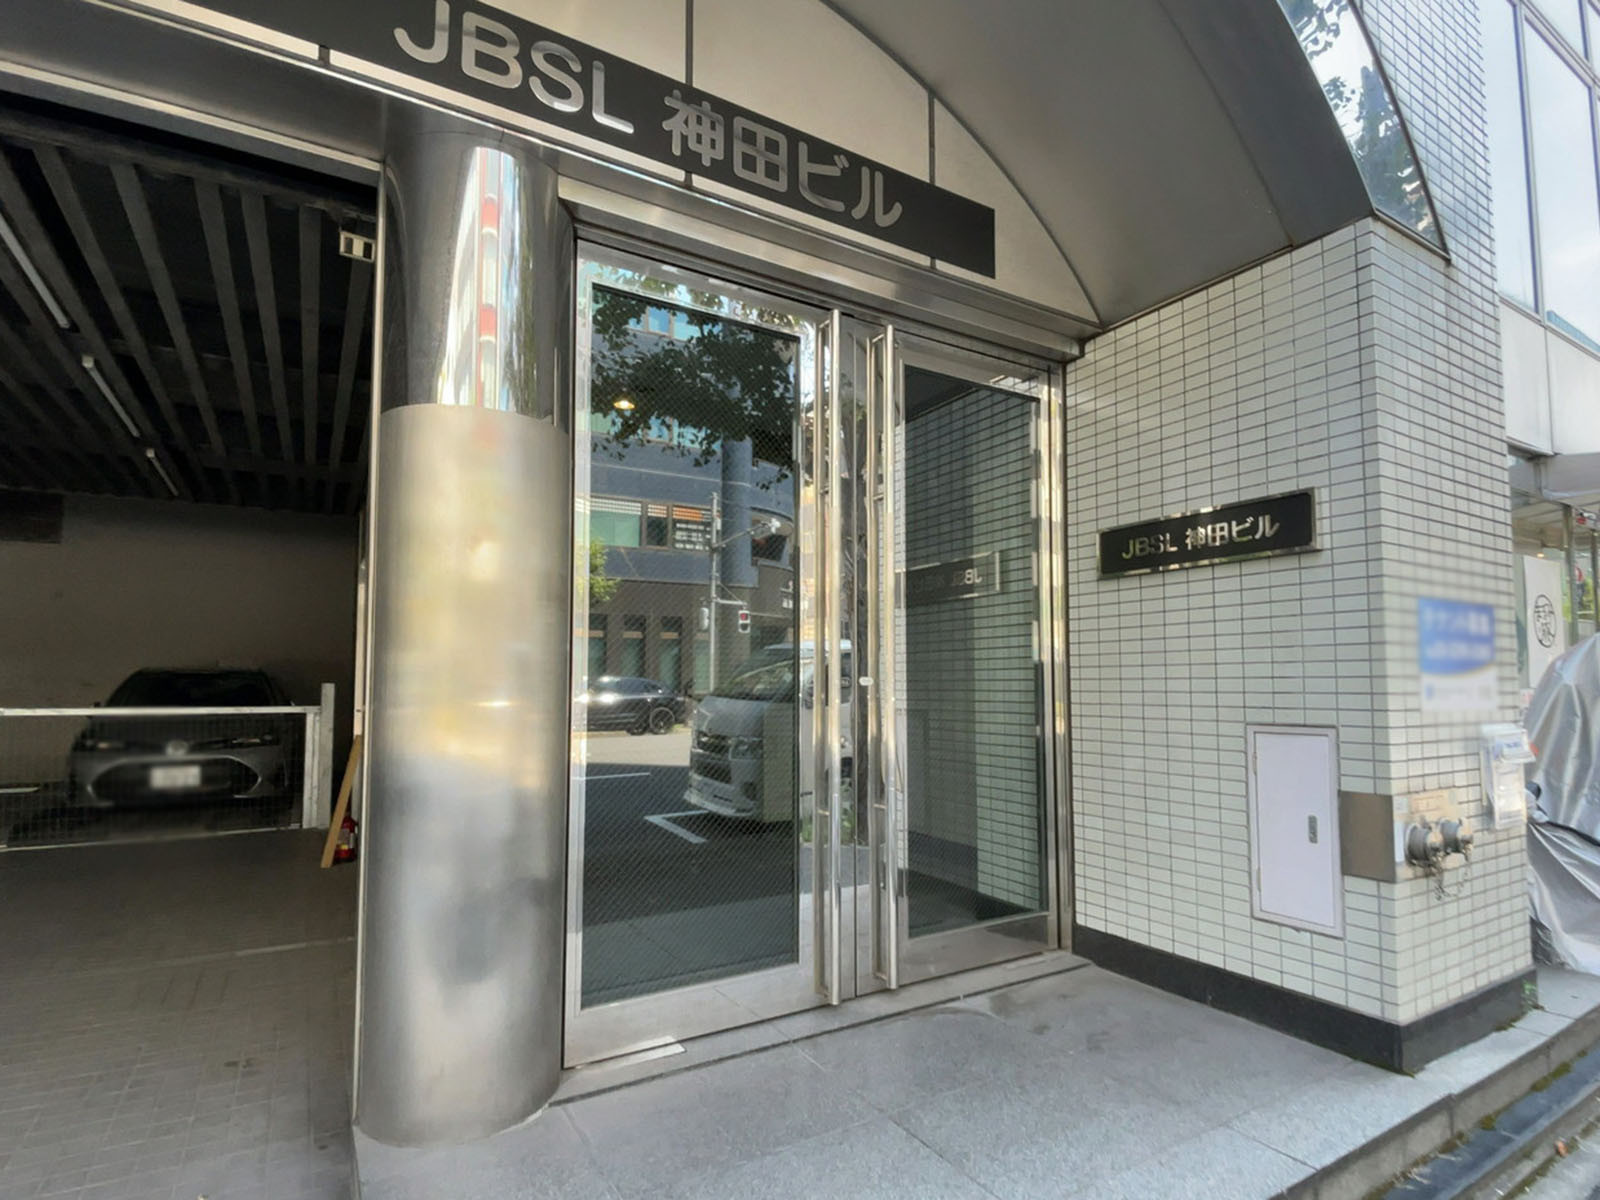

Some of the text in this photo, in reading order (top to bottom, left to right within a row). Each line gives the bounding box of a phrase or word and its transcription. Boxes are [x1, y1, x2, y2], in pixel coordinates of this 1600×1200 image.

[394, 0, 903, 228] JBSL 神田ビル
[1122, 515, 1280, 559] JBSL 神田ビル
